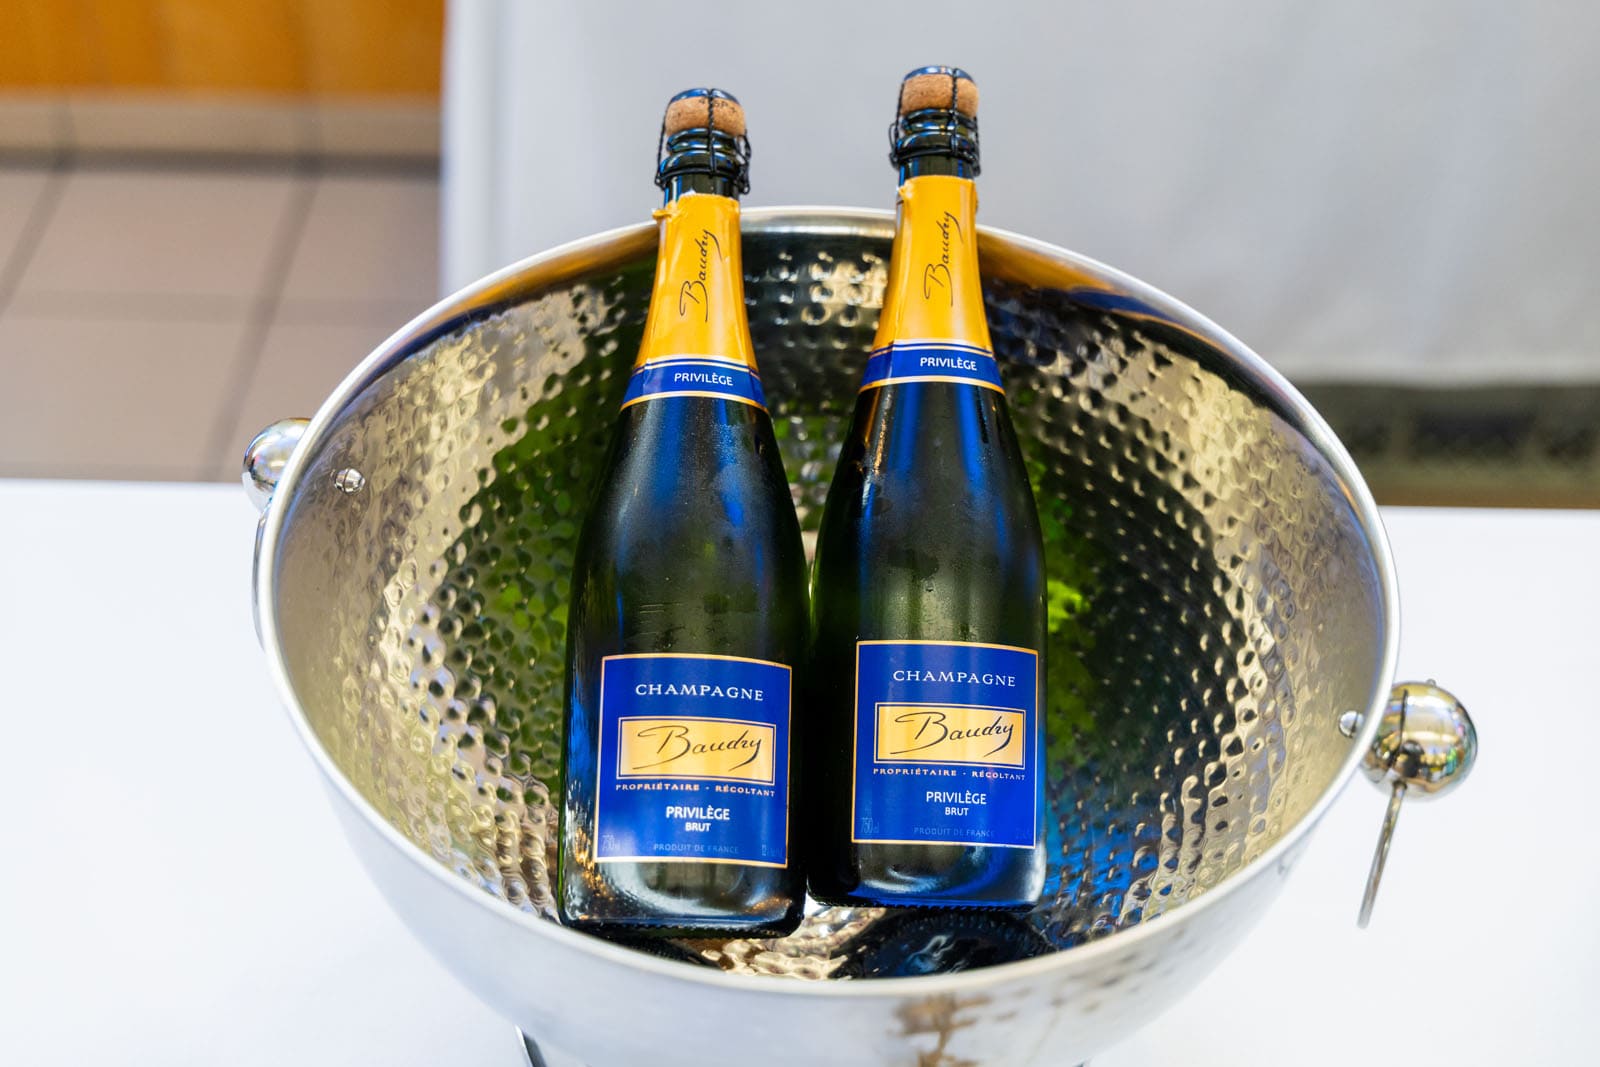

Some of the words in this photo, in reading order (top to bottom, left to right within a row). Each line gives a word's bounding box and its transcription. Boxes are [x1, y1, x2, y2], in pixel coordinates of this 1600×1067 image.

[924, 211, 964, 307] Baudry
[679, 229, 722, 323] Baudry
[919, 356, 977, 371] PRIVILÈGE
[674, 372, 734, 386] PRIVILÈGE
[893, 670, 1016, 687] CHAMPAGNE
[635, 683, 764, 701] CHAMPAGNE
[889, 711, 1014, 757] Baudry
[632, 725, 762, 772] Baudry
[873, 767, 957, 777] PROPRIÉTAIRE
[971, 769, 1026, 781] RÉCOLTANT
[615, 782, 700, 792] PROPRIÉTAIRE
[715, 784, 776, 797] RÉCOLTANT
[926, 790, 987, 805] PRIVILÈGE
[665, 805, 731, 821] PRIVILÈGE
[944, 806, 970, 816] BRUT
[685, 822, 711, 832] BRUT
[913, 826, 951, 837] PRODUIT
[966, 828, 995, 838] FRANCE
[653, 843, 692, 852] PRODUIT
[694, 844, 705, 852] DE
